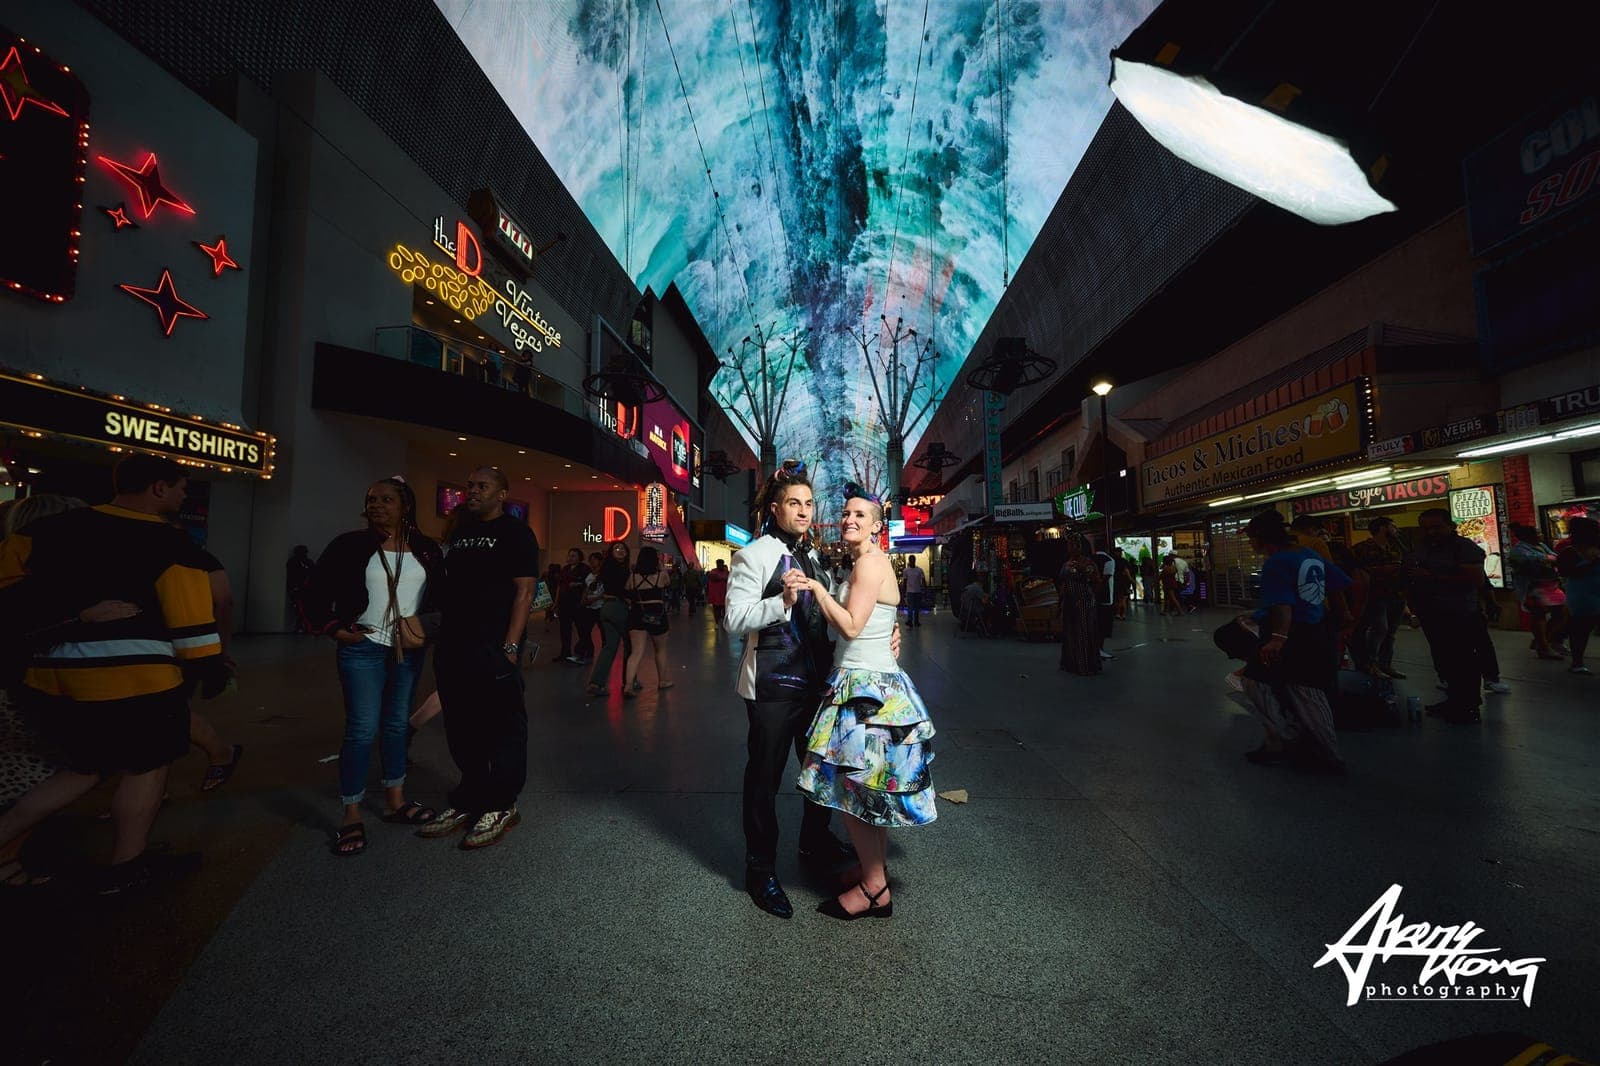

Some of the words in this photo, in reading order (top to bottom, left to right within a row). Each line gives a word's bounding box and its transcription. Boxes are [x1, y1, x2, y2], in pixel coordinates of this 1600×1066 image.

[434, 215, 456, 252] the
[456, 219, 484, 277] D
[495, 300, 542, 353] Vegas
[506, 280, 561, 347] Vintage
[599, 391, 617, 433] the
[1444, 419, 1481, 438] VEGAS
[104, 410, 260, 465] SWEATSHIRTS
[1144, 460, 1186, 486] Tacos
[1193, 447, 1208, 472] &
[1214, 419, 1303, 467] Miches
[1371, 441, 1401, 454] TRULY
[1164, 477, 1211, 498] Authentic
[1212, 461, 1263, 484] Mexican
[1266, 446, 1304, 472] Food
[1295, 493, 1347, 513] STREET
[1385, 475, 1447, 501] TACOS
[1455, 498, 1490, 510] GELATO
[1456, 491, 1487, 502] PIZZA
[582, 525, 603, 543] the
[603, 505, 633, 544] D
